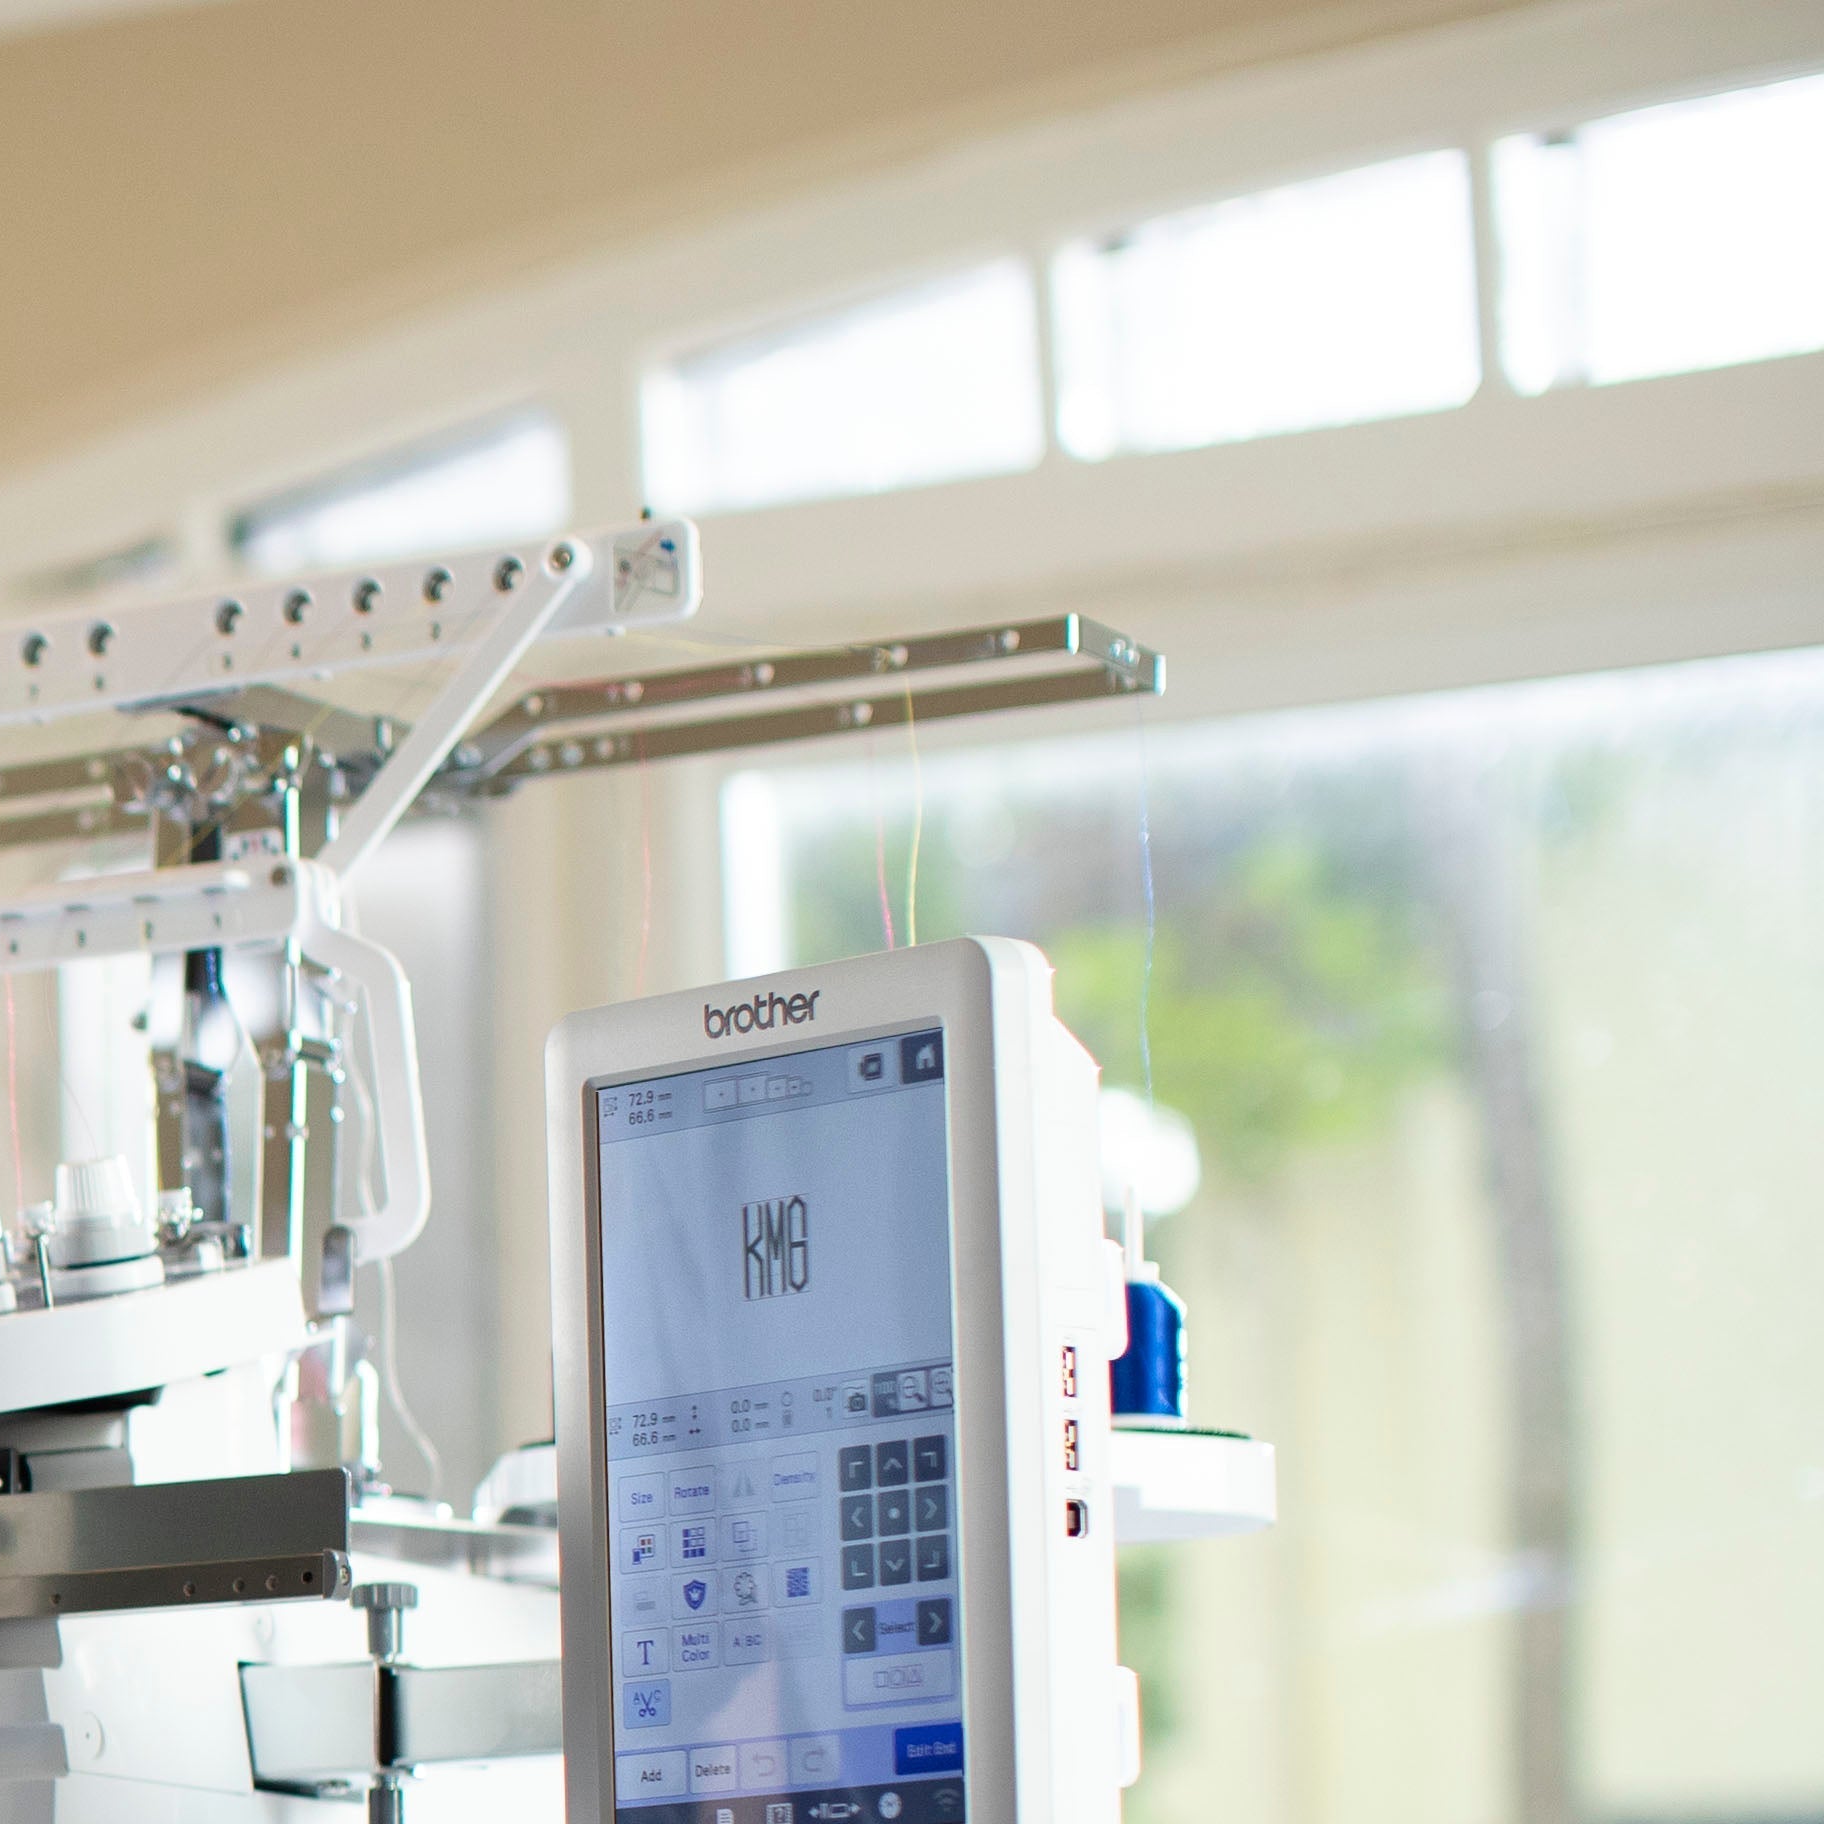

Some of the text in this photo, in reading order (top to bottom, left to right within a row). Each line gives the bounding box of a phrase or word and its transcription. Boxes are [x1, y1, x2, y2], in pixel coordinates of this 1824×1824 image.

[703, 989, 820, 1040] brother
[628, 1090, 655, 1107] 72.9
[628, 1108, 655, 1125] 66.6
[632, 1412, 659, 1429] 72.9
[632, 1430, 659, 1448] 66.6
[630, 1491, 654, 1506] Size
[673, 1484, 711, 1500] Rotate
[681, 1632, 711, 1648] Multi
[636, 1639, 655, 1667] T
[681, 1648, 712, 1664] Color
[639, 1768, 663, 1784] Add
[694, 1762, 732, 1779] Delete
